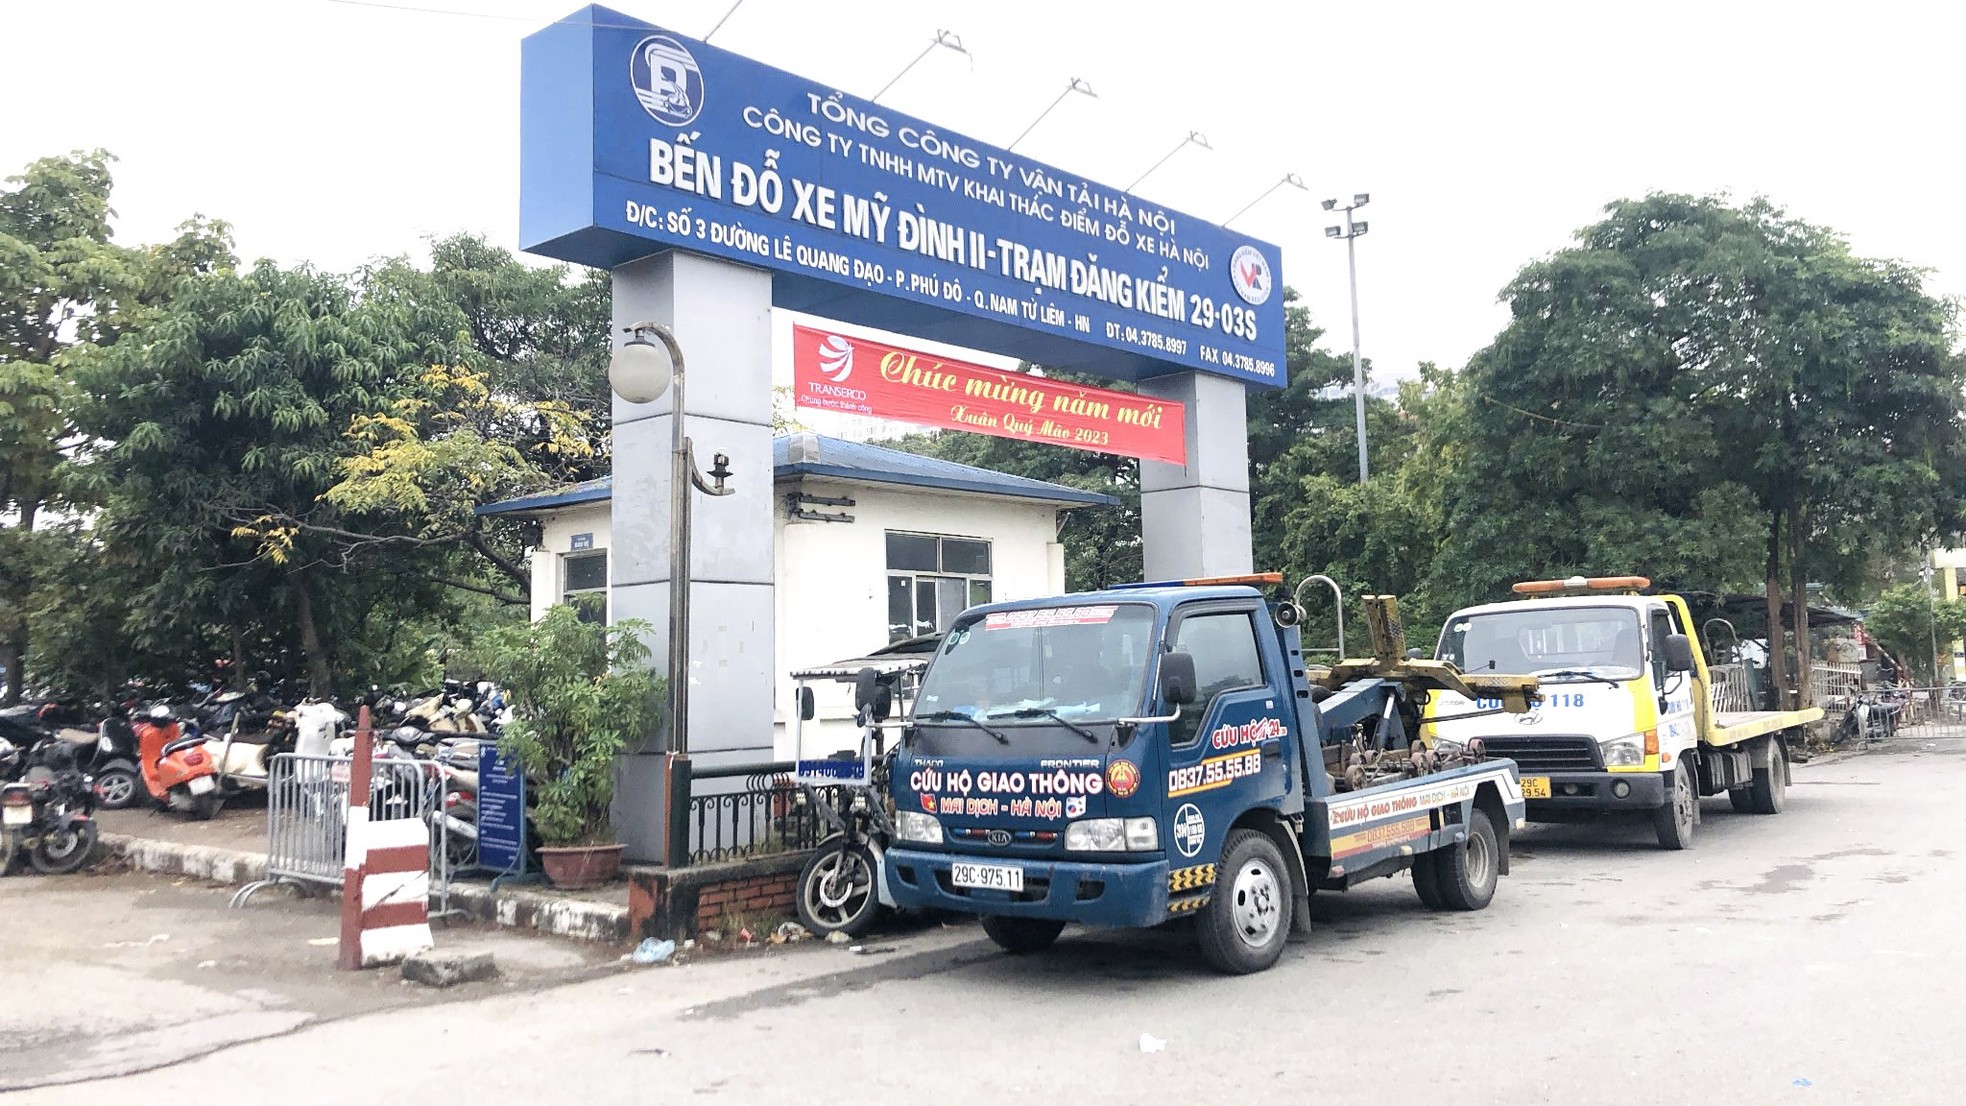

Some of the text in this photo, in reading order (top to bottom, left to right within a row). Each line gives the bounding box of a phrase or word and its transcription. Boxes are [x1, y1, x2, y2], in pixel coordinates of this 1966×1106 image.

[807, 92, 1175, 236] TỔNG CÔNG TY VẬN TẢI HÀ NỘI
[743, 105, 821, 148] CÔNG
[827, 132, 852, 157] TY
[859, 143, 912, 178] TNHH
[918, 163, 959, 192] MTV
[964, 179, 1004, 207] KHAI
[1009, 193, 1054, 221] THÁC
[1060, 208, 1100, 237] ĐIỂM
[1105, 220, 1130, 245] ĐỖ
[1136, 233, 1155, 254] XE
[1159, 240, 1180, 261] HÀ
[1183, 248, 1209, 272] NỘI
[650, 131, 722, 200] BẾN
[731, 149, 783, 214] ĐỖ
[791, 178, 836, 230] XE
[843, 192, 891, 243] MỸ
[897, 203, 965, 265] ĐÌNH
[1069, 253, 1133, 309] ĐĂNG
[1136, 266, 1186, 322] KIỂM
[1190, 294, 1257, 341] 29-03S
[626, 201, 664, 230] Đ/C:
[667, 208, 692, 236] SỐ
[696, 219, 706, 239] 3
[710, 221, 769, 257] ĐƯỜNG
[774, 236, 792, 262] LÊ
[797, 246, 850, 276] QUANG
[854, 259, 884, 287] ĐẠO
[943, 279, 962, 302] ĐÔ
[1021, 297, 1037, 320] TỪ
[1040, 303, 1065, 327] LIÊM
[1074, 314, 1090, 333] HN
[1200, 346, 1275, 378] FAX 04.3785.8996
[808, 382, 867, 401] TRANSERCO
[880, 351, 1162, 430] Chúc mừng năm mới
[950, 404, 1109, 446] Xuân Quý Mão 2023
[1550, 694, 1584, 707] 118
[1212, 724, 1239, 749] CỨU
[1240, 719, 1258, 747] HỘ
[1040, 759, 1100, 769] FRONTIER
[1168, 753, 1261, 792] 0837.55.55.88
[910, 767, 942, 792] CỨU
[947, 769, 972, 796] HỘ
[976, 771, 1025, 794] GIAO
[1029, 769, 1103, 794] THÔNG
[1521, 778, 1538, 787] 29C
[1521, 788, 1546, 798] 29.54
[940, 797, 965, 814] MAI
[967, 798, 998, 819] DỊCH
[1010, 797, 1032, 817] HÀ
[1034, 799, 1062, 821] NỘI
[1371, 802, 1390, 816] GIAO
[1392, 796, 1417, 812] THÔNG
[991, 831, 1009, 844] KIA
